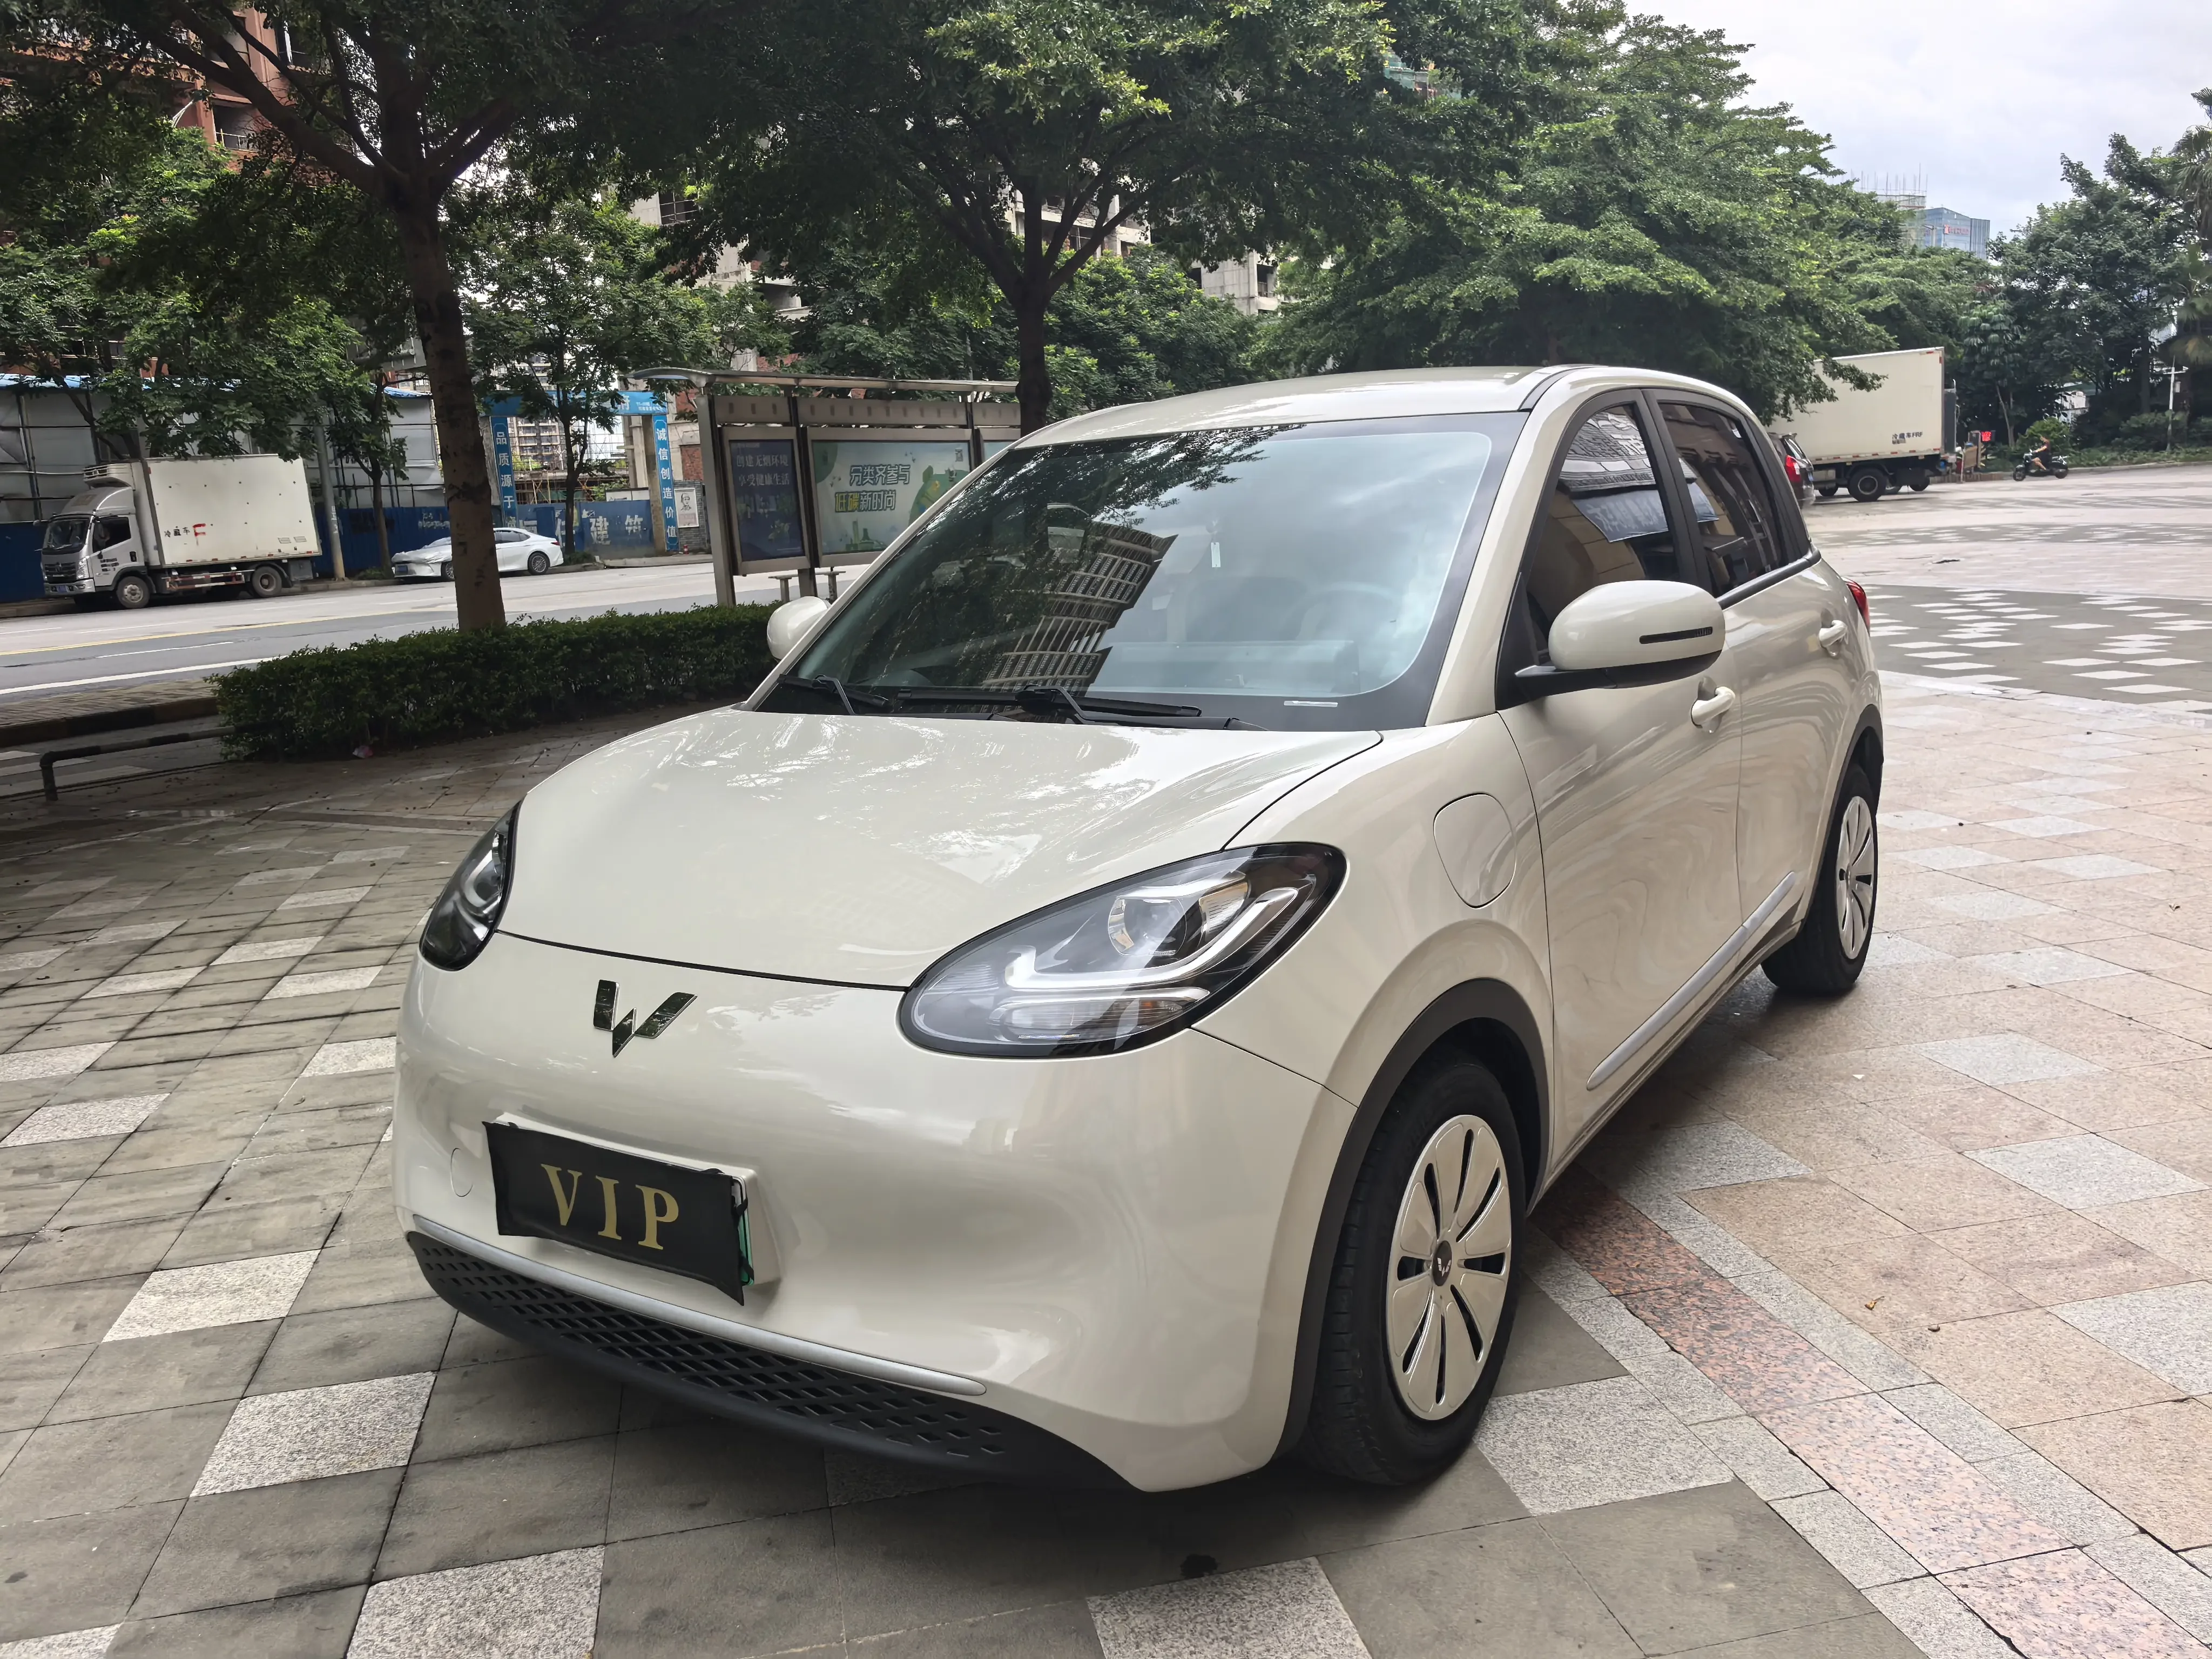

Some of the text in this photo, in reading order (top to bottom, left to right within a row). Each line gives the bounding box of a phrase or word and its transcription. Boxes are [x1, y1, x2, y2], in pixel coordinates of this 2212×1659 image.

[657, 428, 676, 538] 诚信创造价值
[738, 473, 790, 487] 享受健康生活
[850, 465, 911, 485] 分类齐参与
[835, 490, 896, 512] 低碳新时尚
[540, 1163, 679, 1250] VIP
